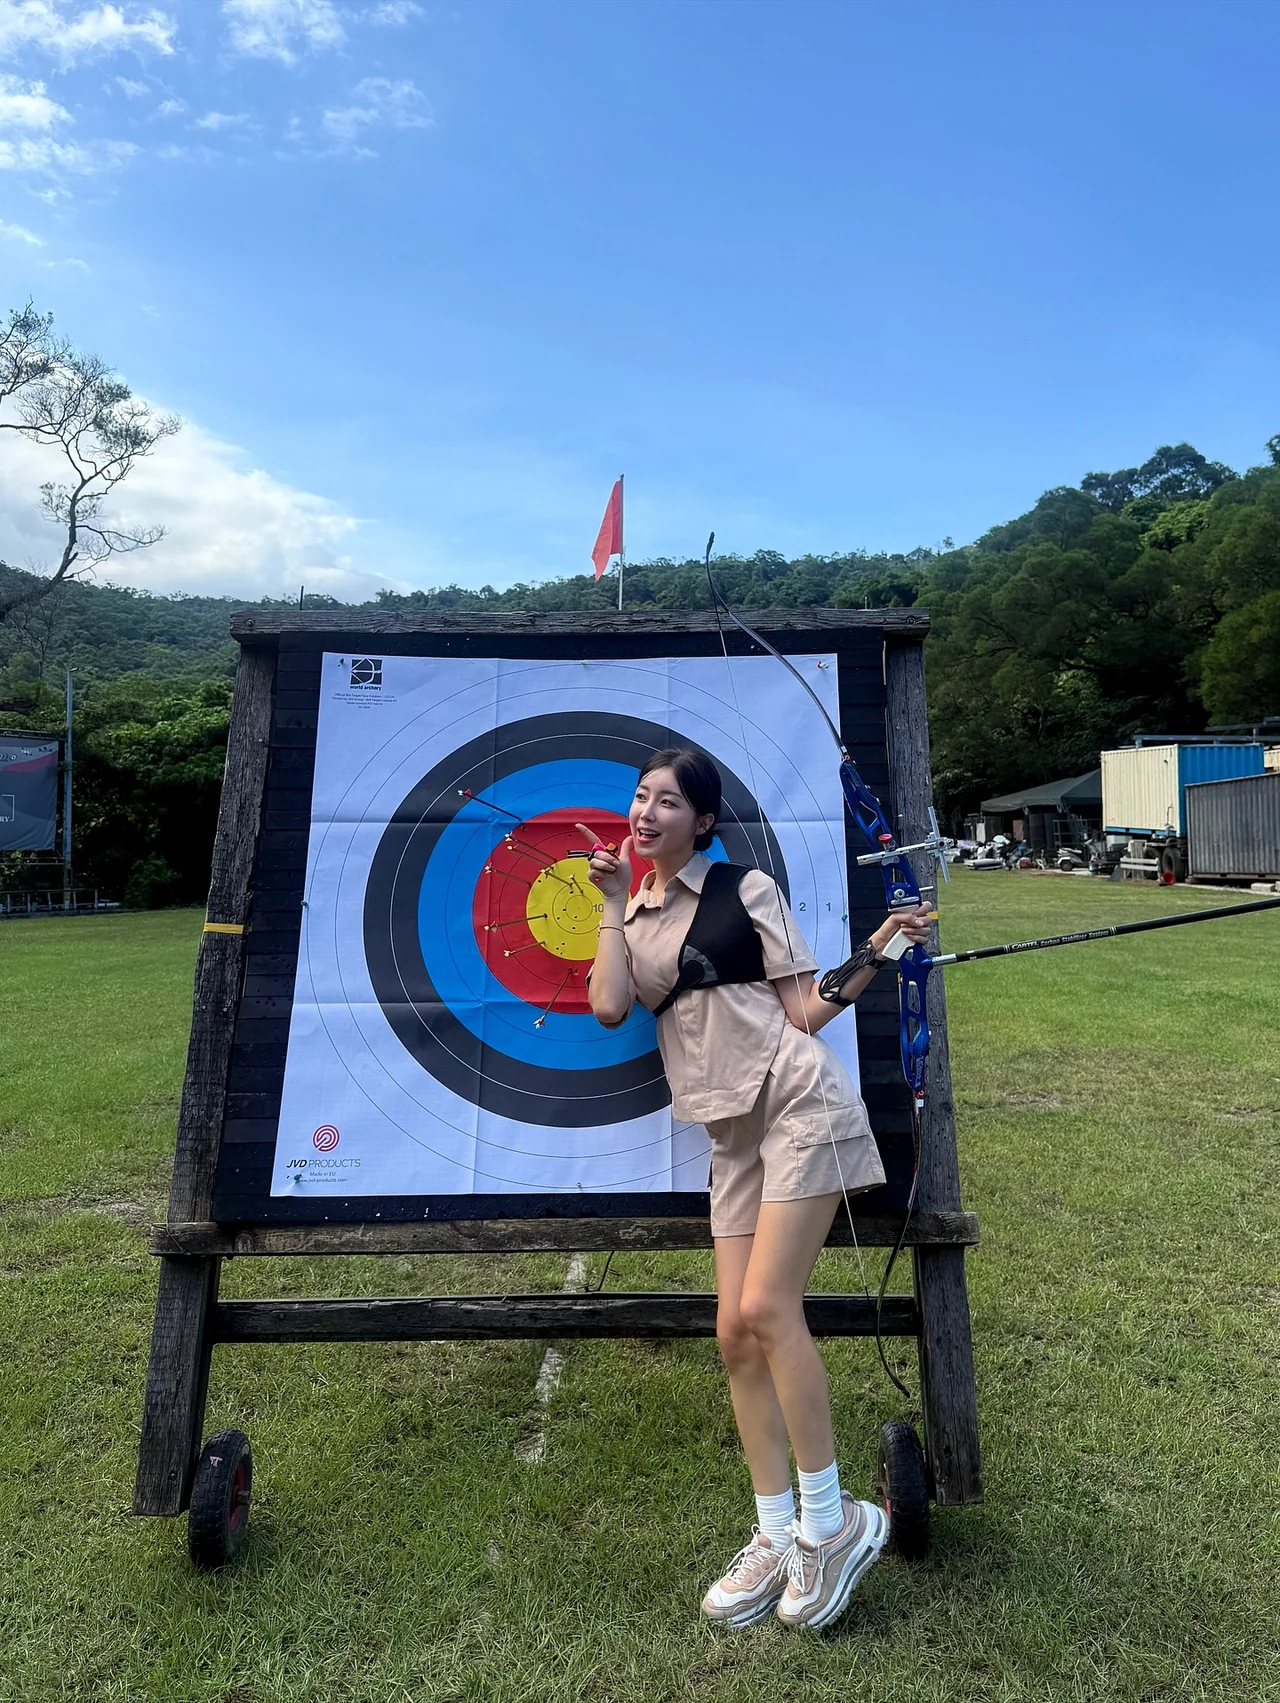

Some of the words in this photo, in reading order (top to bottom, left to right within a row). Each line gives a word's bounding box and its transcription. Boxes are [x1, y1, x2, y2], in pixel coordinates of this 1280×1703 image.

[593, 903, 604, 913] 10
[799, 902, 806, 911] 2
[826, 902, 831, 911] 1
[1012, 941, 1039, 949] CARTEL
[1040, 938, 1060, 946] Carbon
[1088, 930, 1109, 938] System
[286, 1160, 307, 1168] JVD
[308, 1159, 361, 1168] PRODUCTS
